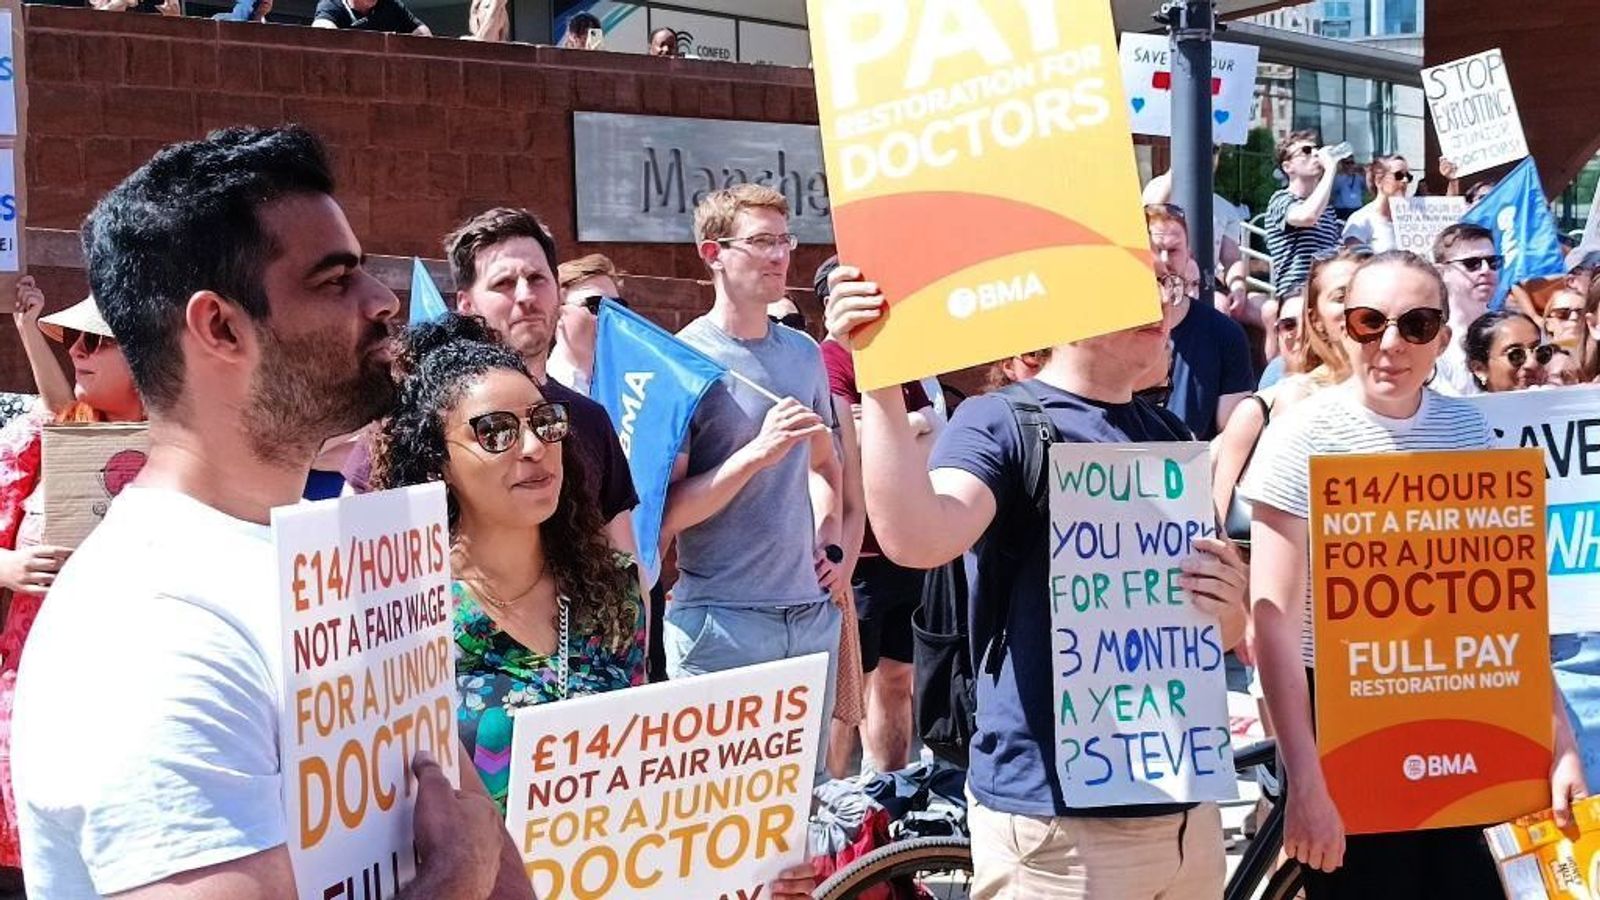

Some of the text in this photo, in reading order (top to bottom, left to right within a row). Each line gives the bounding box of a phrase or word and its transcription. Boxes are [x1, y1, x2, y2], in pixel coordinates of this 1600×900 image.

[697, 45, 731, 60] CONFED
[1134, 47, 1168, 65] SAVE
[834, 44, 1102, 137] RESTORATION FOR
[1428, 54, 1501, 100] STOP
[840, 77, 1112, 190] DOCTORS
[1432, 88, 1511, 134] EXPLOITING
[979, 271, 1048, 311] BMA
[619, 371, 656, 462] BMA
[1494, 418, 1600, 480] VE
[1054, 458, 1184, 501] WOULD
[1323, 470, 1533, 506] £14/HOUR IS
[1052, 520, 1121, 560] YOU
[1323, 505, 1535, 536] NOT A FAIR WAGE
[292, 522, 444, 612] £14/HOUR IS
[1325, 534, 1536, 570] FOR A JUNIOR
[1051, 573, 1111, 614] FOR
[1326, 568, 1537, 621] DOCTOR
[293, 584, 447, 674] NOT A FAIR WAGE
[1056, 624, 1222, 678] 3 MONTHS
[1349, 632, 1521, 677] FULL PAY
[296, 636, 449, 746] FOR A JUNIOR
[1061, 679, 1187, 726] A YEAR
[1350, 670, 1521, 697] RESTORATION NOW
[531, 685, 810, 773] £14/HOUR IS
[299, 695, 453, 850] DOCTOR
[527, 728, 805, 811] NOT A FAIR WAGE
[1428, 753, 1478, 777] BMA
[524, 763, 801, 855] FOR A JUNIOR
[525, 803, 796, 900] DOCTOR
